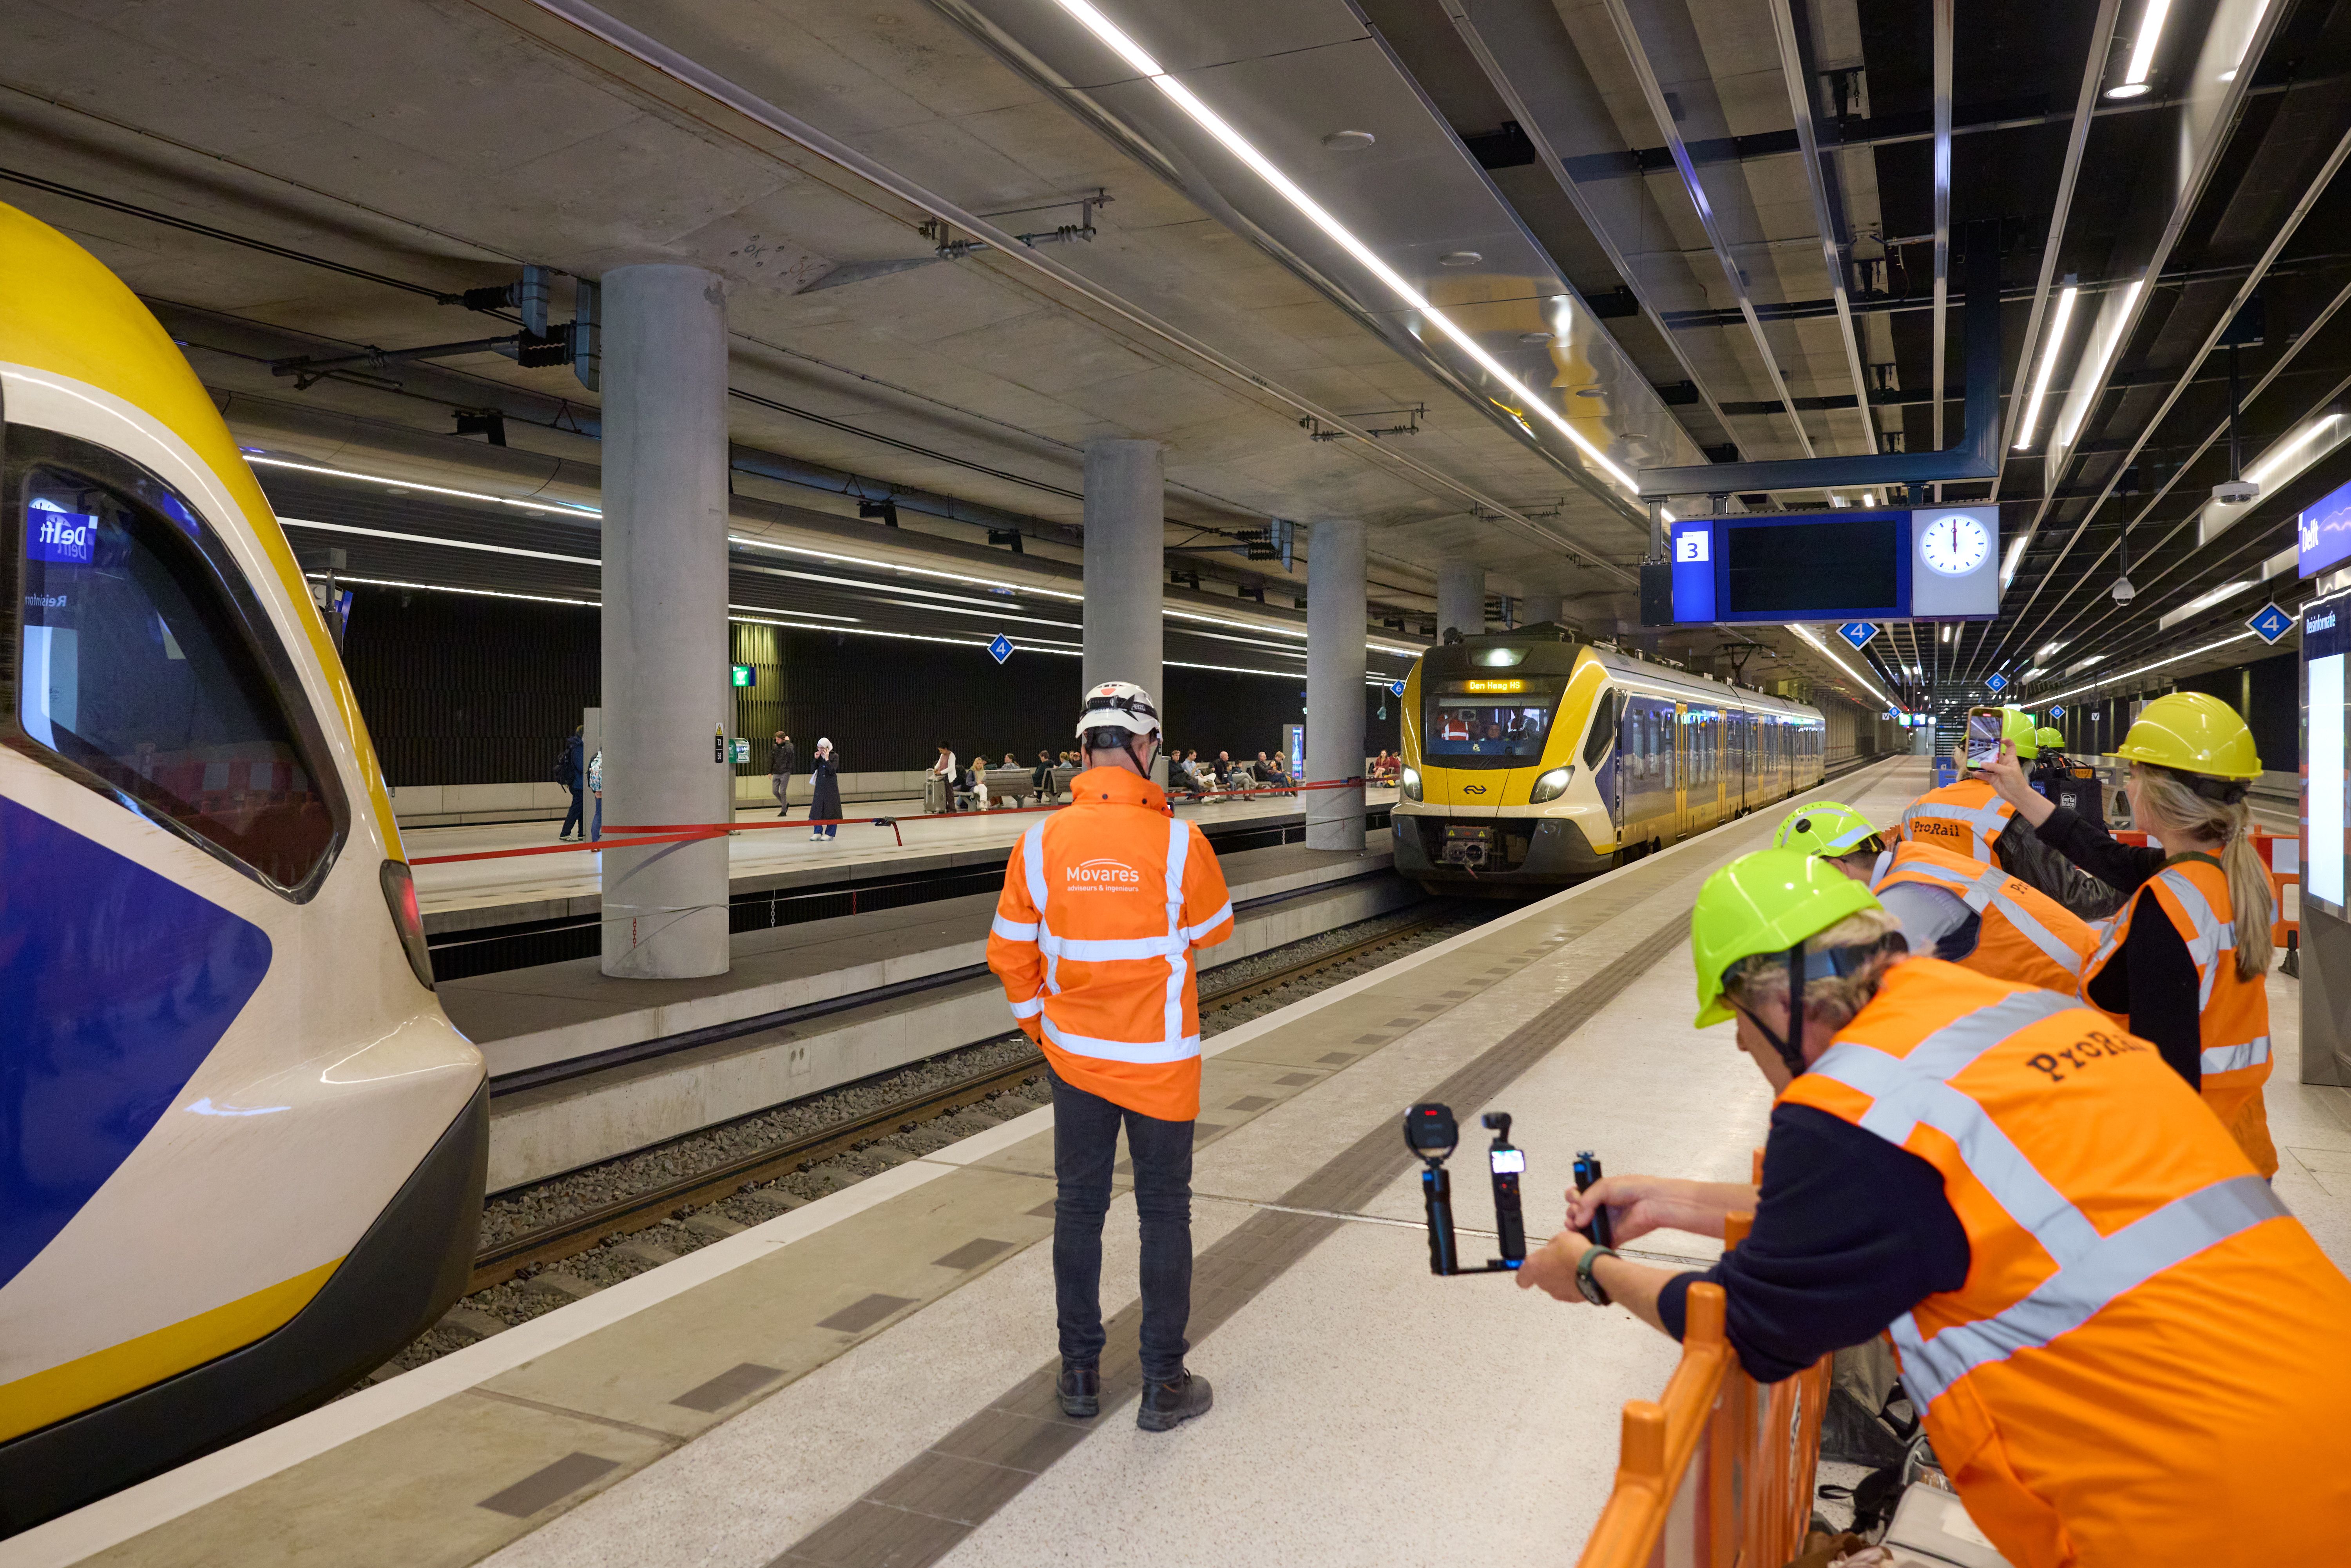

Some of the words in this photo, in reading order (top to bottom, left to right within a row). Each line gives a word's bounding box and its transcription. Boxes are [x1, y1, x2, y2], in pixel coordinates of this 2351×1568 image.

[2302, 518, 2319, 553] Delft
[1687, 543, 1698, 559] 3
[2262, 615, 2280, 631] 4
[2306, 610, 2336, 634] Reisinformatie
[1850, 623, 1865, 638] 4
[996, 642, 1006, 654] 4
[1487, 682, 1507, 690] Haag
[1993, 678, 2000, 687] 6
[1914, 821, 1960, 837] ProRail
[1067, 867, 1139, 882] Movares
[1105, 884, 1139, 893] ingenieurs
